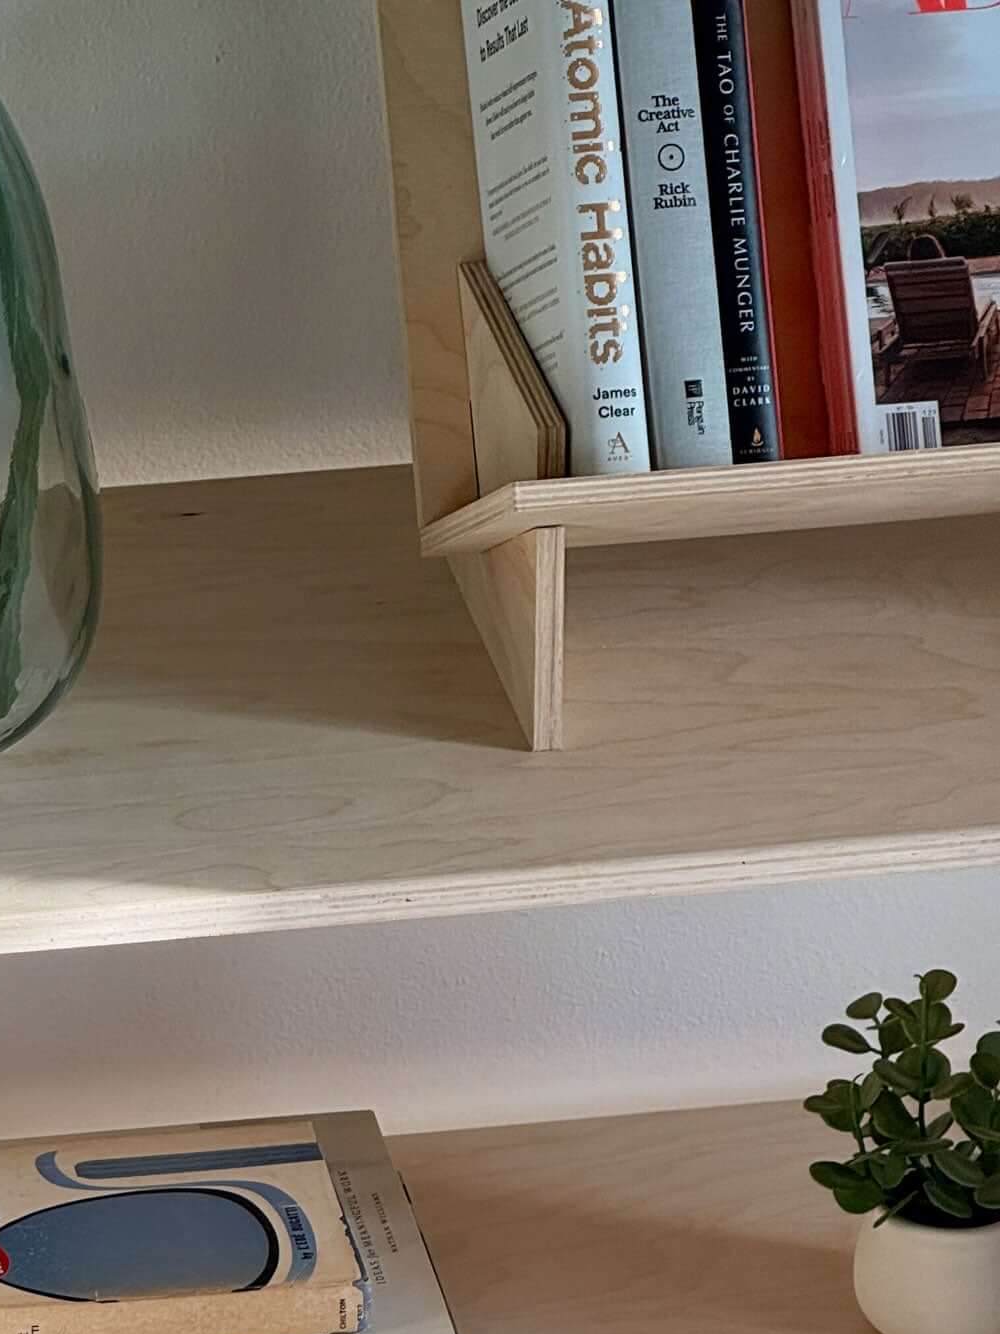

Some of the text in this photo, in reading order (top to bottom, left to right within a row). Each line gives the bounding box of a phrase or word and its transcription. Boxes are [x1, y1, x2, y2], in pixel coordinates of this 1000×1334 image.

[486, 32, 505, 58] Results
[504, 24, 518, 46] That
[517, 15, 529, 38] Last
[651, 95, 680, 108] The
[637, 106, 696, 122] Creative
[656, 121, 681, 134] Act
[714, 13, 756, 333] THE TAO OF CHARLIE MUNGER
[559, 0, 629, 365] Atomic Habits
[657, 182, 691, 196] Rick
[652, 195, 697, 210] Rubin
[593, 387, 637, 401] James
[732, 384, 770, 395] DAVID
[733, 396, 771, 407] CLARK
[598, 406, 636, 419] Clear
